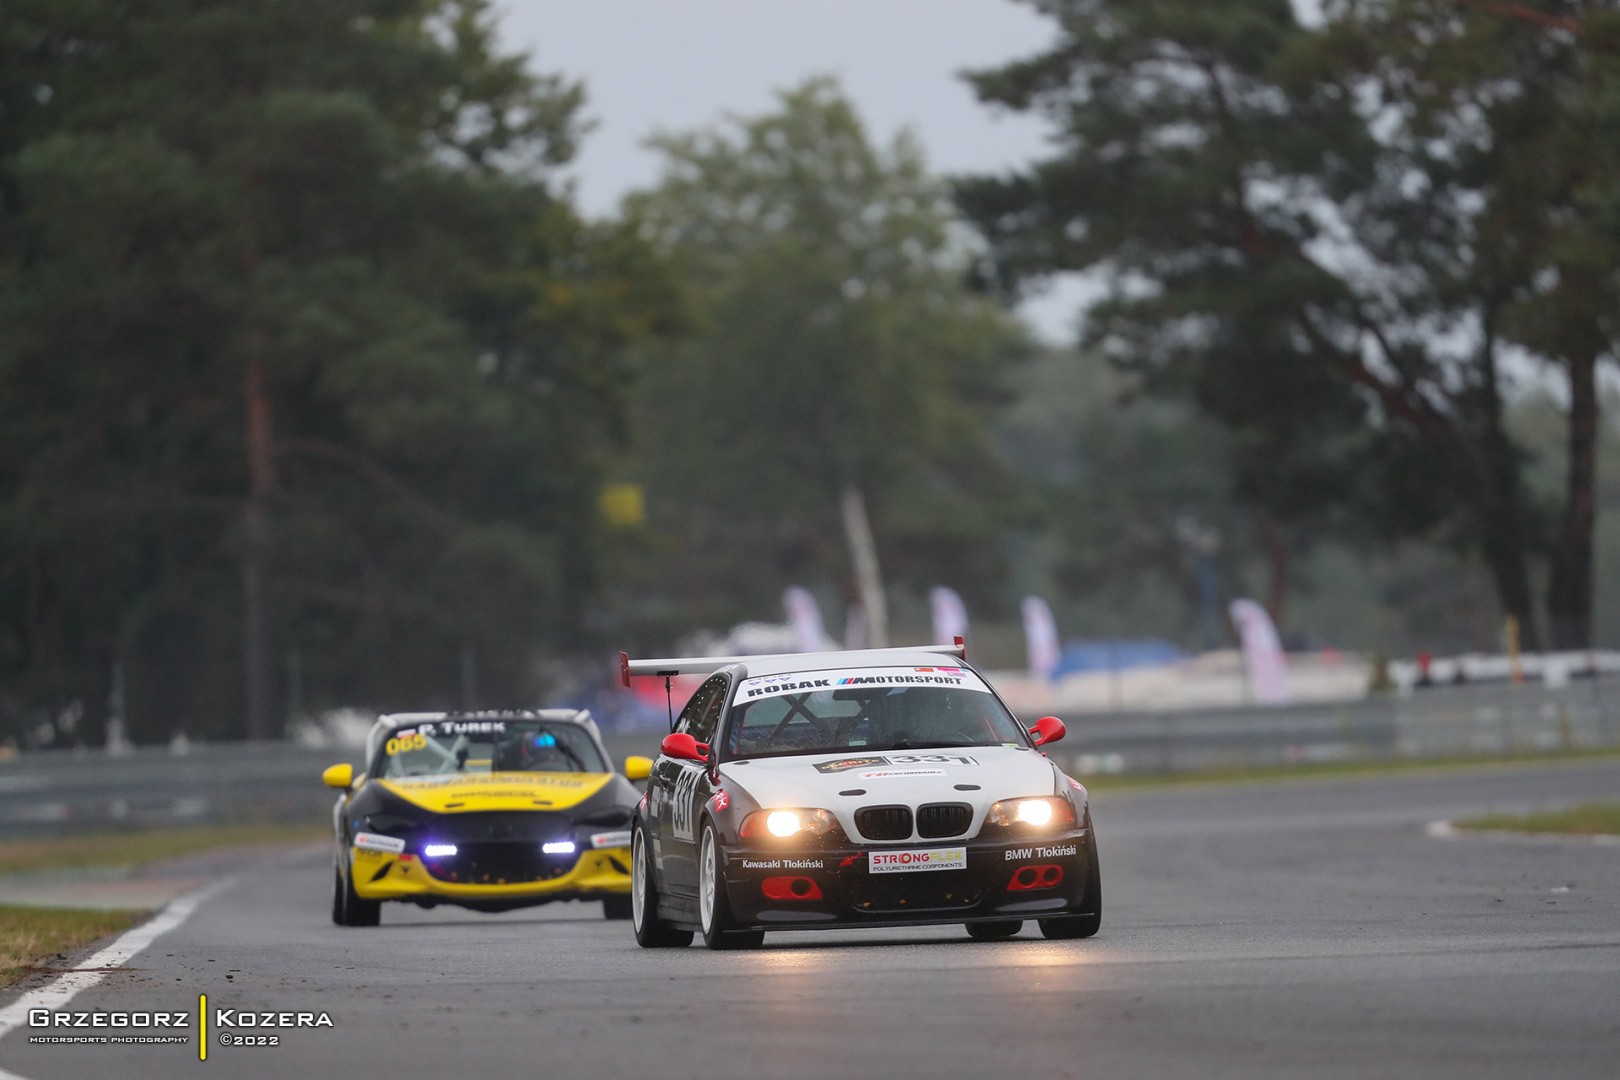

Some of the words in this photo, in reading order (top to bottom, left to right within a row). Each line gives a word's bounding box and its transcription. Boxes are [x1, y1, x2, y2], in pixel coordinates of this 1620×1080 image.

[747, 678, 831, 697] ROBAK
[851, 675, 962, 685] MOTORSPORT
[441, 721, 506, 734] TUREK
[892, 755, 972, 765] 331
[673, 770, 698, 832] 331
[873, 850, 961, 864] STRONGFLEX
[1005, 848, 1032, 861] BMW
[1036, 845, 1077, 857] Tłokiński
[742, 859, 781, 868] Kawasaki
[783, 859, 824, 868] Tłokiński
[873, 864, 922, 872] POLYURETHANE
